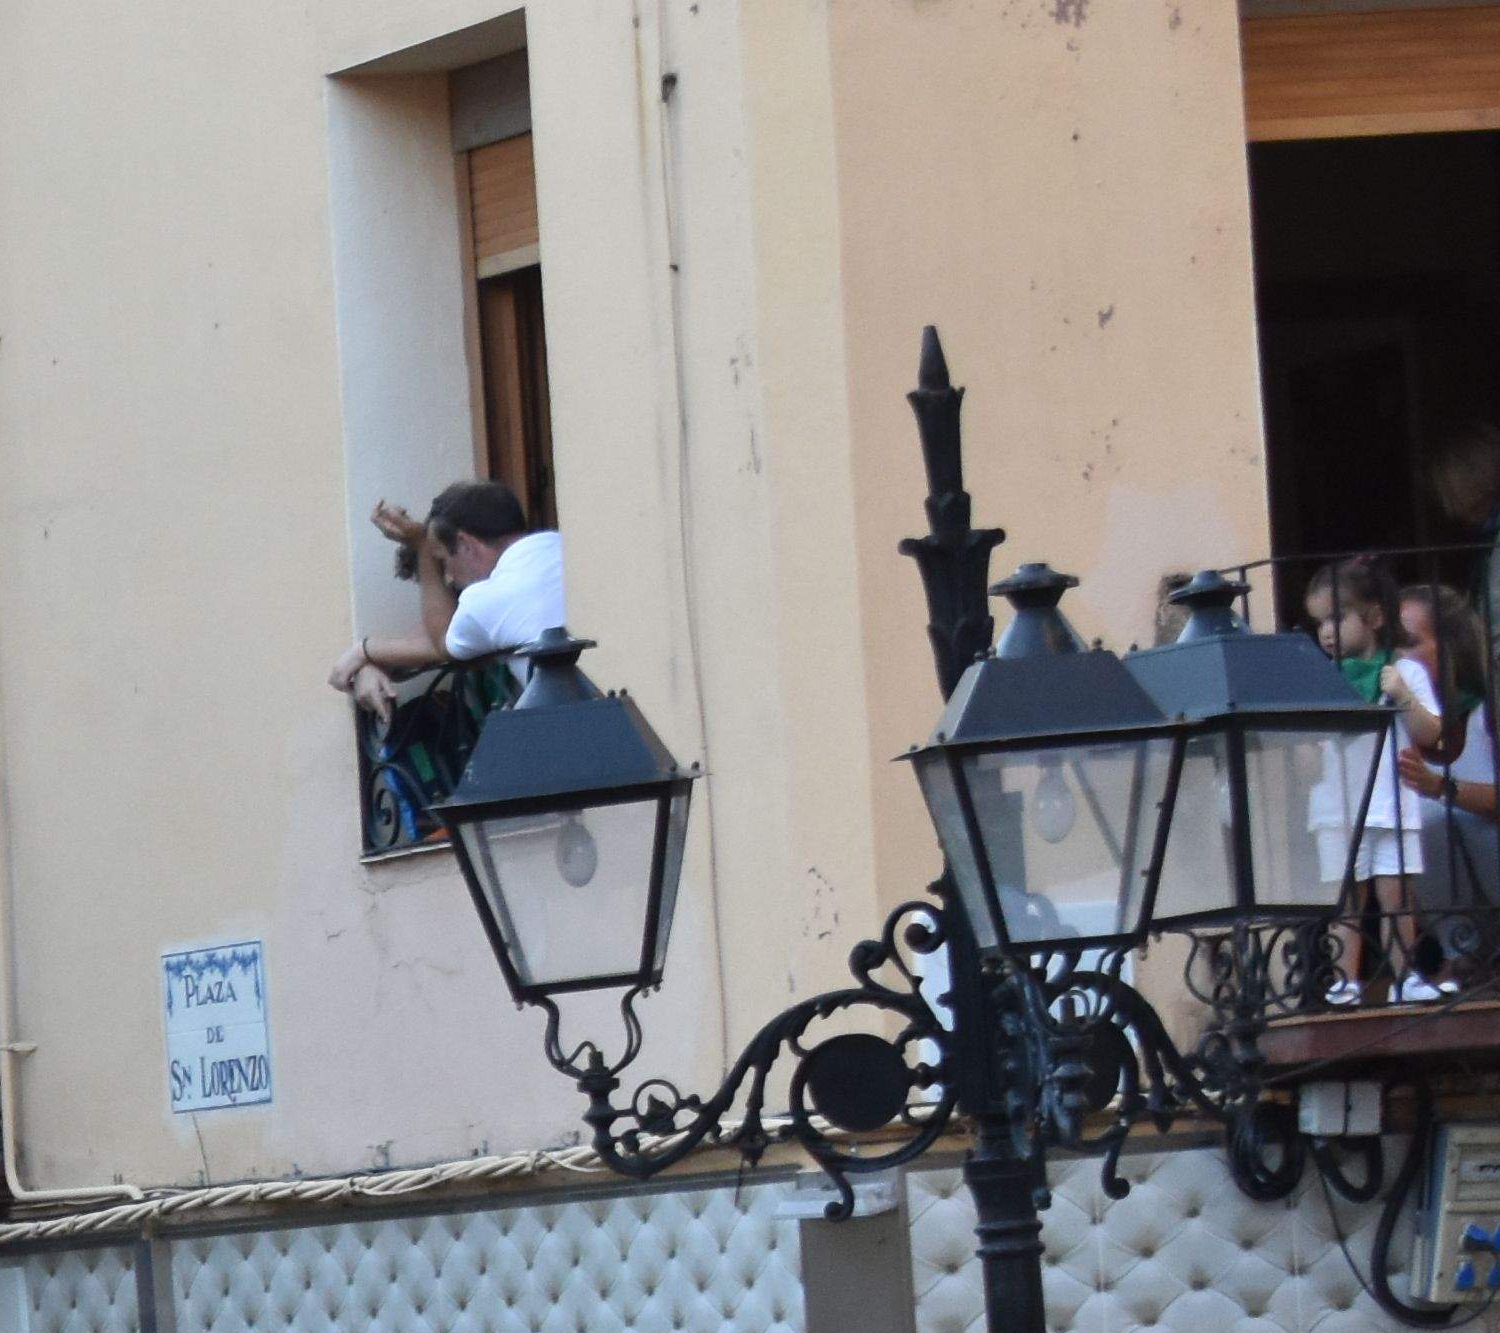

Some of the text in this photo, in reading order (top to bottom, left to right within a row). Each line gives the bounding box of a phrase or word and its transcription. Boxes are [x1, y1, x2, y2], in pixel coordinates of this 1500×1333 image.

[184, 974, 238, 1008] PLAZA
[206, 1025, 225, 1044] DE
[199, 1054, 269, 1103] LORENZO
